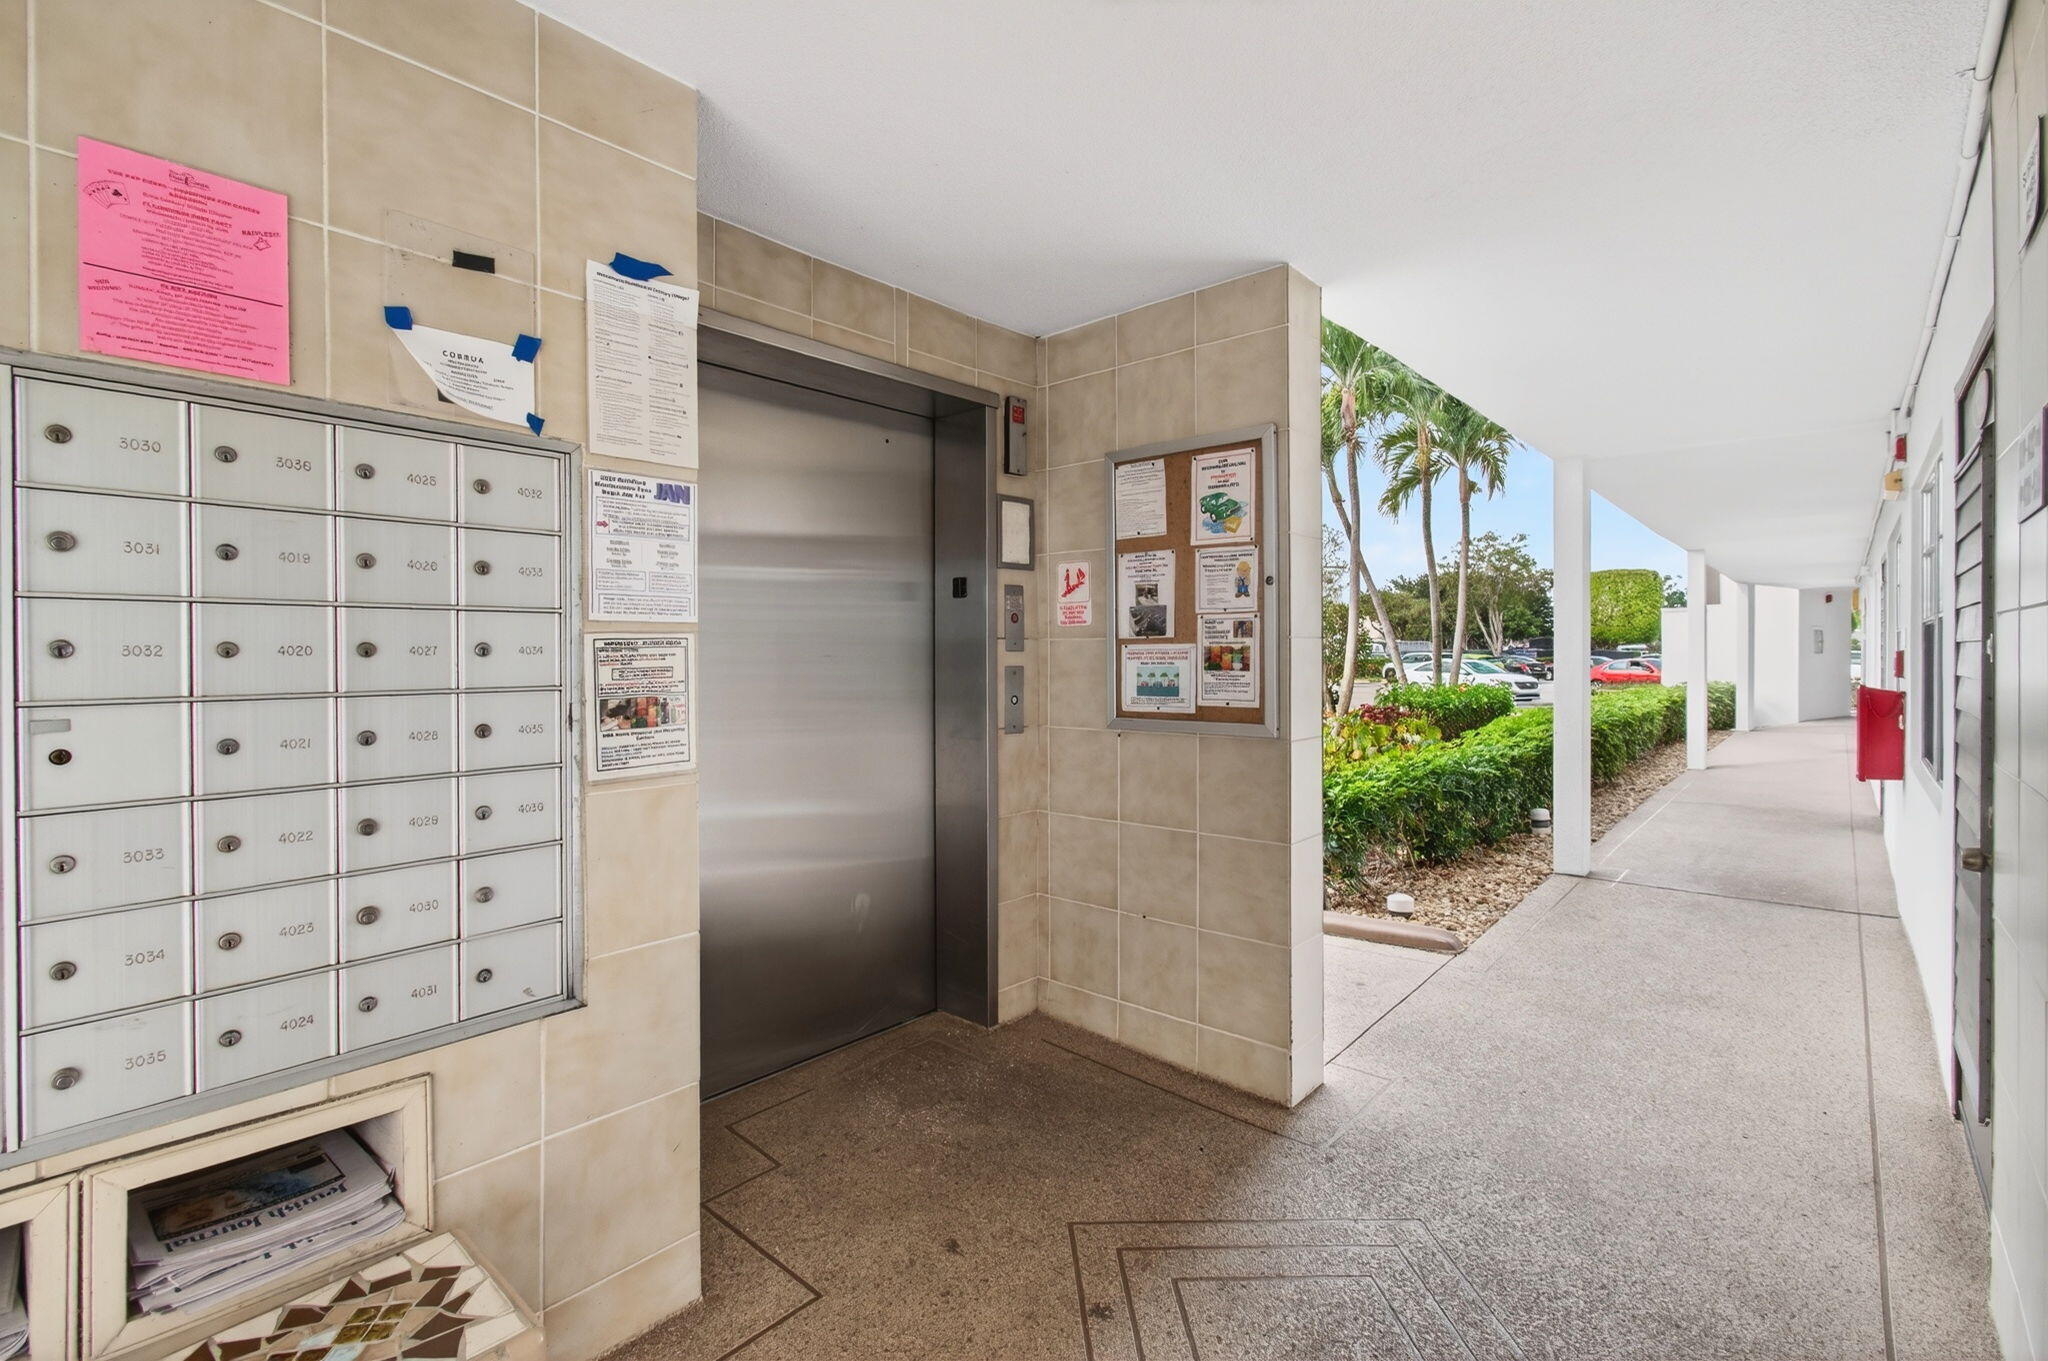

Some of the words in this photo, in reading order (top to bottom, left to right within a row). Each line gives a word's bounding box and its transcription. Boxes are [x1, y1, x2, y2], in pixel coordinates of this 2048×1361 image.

[119, 436, 162, 454] 3030
[406, 473, 437, 487] 4025
[653, 482, 691, 505] JAN
[123, 540, 160, 556] 3031
[406, 559, 438, 572] 4026
[121, 644, 163, 658] 3032
[277, 644, 314, 657] 4020
[408, 645, 438, 657] 4027
[279, 737, 311, 750] 4021
[408, 730, 439, 742] 4028
[277, 830, 314, 845] 4022
[123, 847, 165, 864] 3033
[408, 899, 439, 913] 4030
[279, 921, 315, 937] 4023
[124, 948, 166, 967] 3034
[410, 984, 438, 999] 4031
[279, 1014, 315, 1032] 4024
[124, 1049, 167, 1071] 3035
[164, 1215, 263, 1253] Journal
